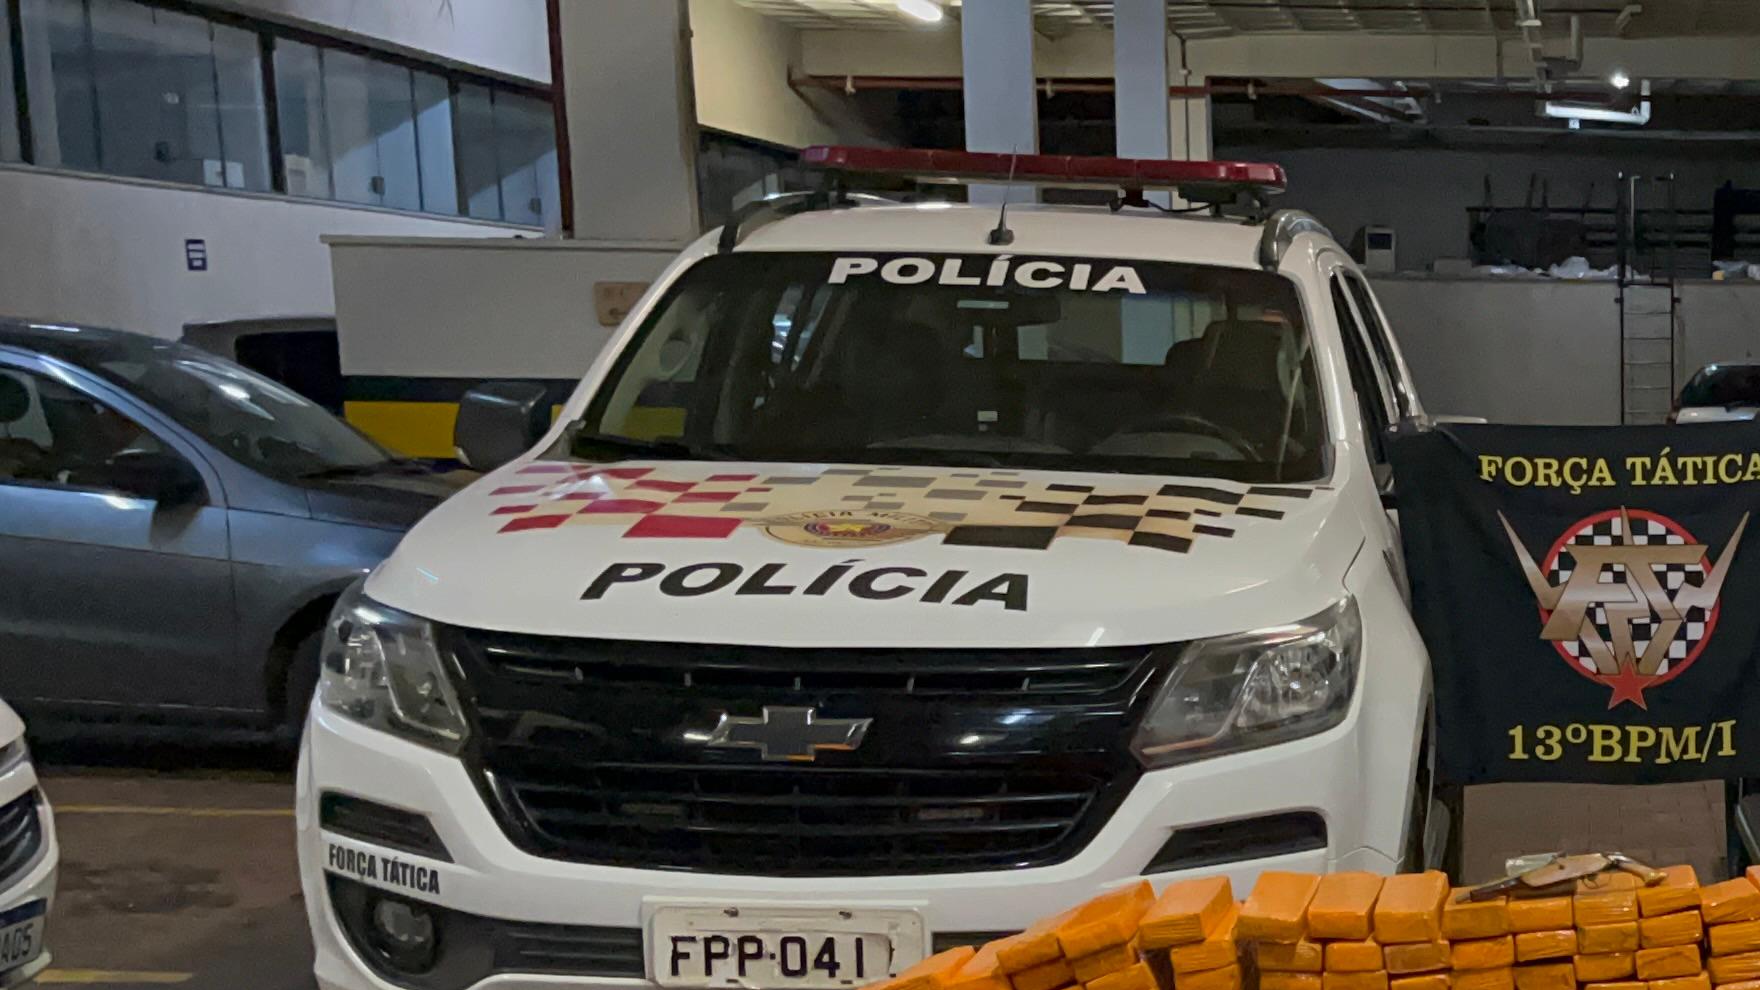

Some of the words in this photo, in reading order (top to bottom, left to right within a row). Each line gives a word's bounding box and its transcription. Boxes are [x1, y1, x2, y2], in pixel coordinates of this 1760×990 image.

[828, 255, 1147, 294] POLÍCIA
[1478, 455, 1616, 494] FORÇA
[579, 559, 1029, 611] POLÍCIA
[381, 856, 440, 895] TÁTICA
[0, 922, 34, 964] A05
